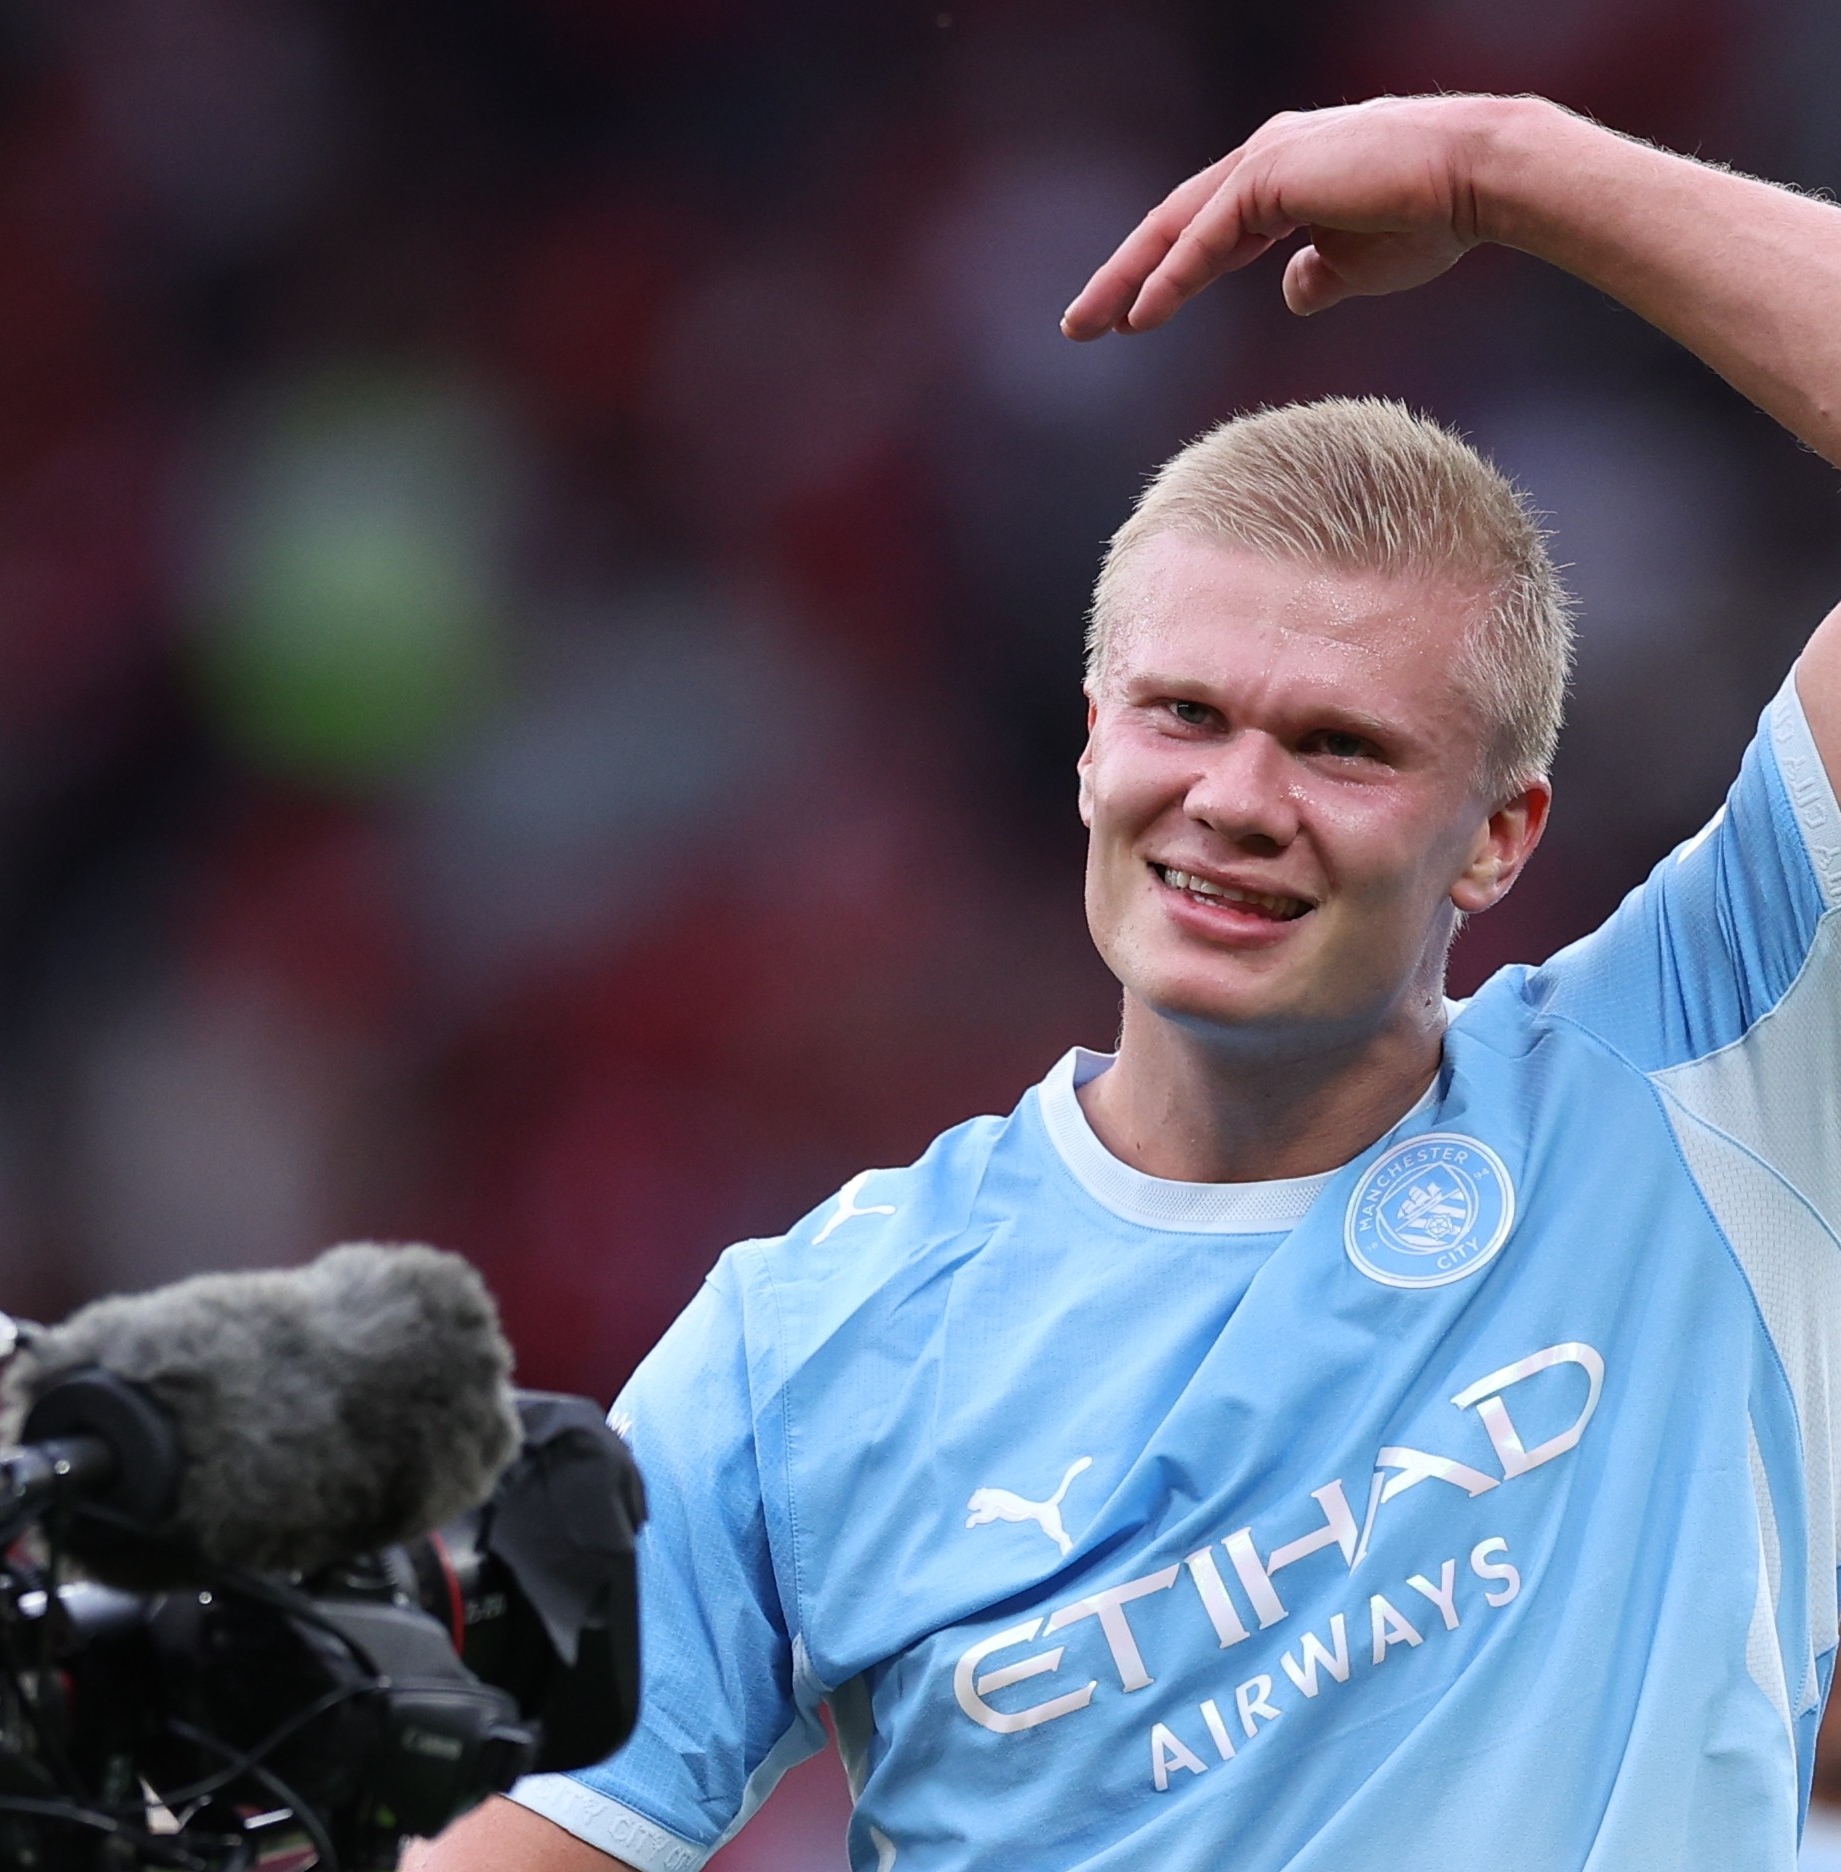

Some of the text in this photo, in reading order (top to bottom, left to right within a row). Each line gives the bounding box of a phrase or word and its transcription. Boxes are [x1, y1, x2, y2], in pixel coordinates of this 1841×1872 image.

[1359, 1146, 1469, 1232] MANCHESTER
[1436, 1236, 1480, 1270] CITY
[953, 1341, 1606, 1734] ETIHAD
[1151, 1536, 1522, 1793] AIRWAYS
